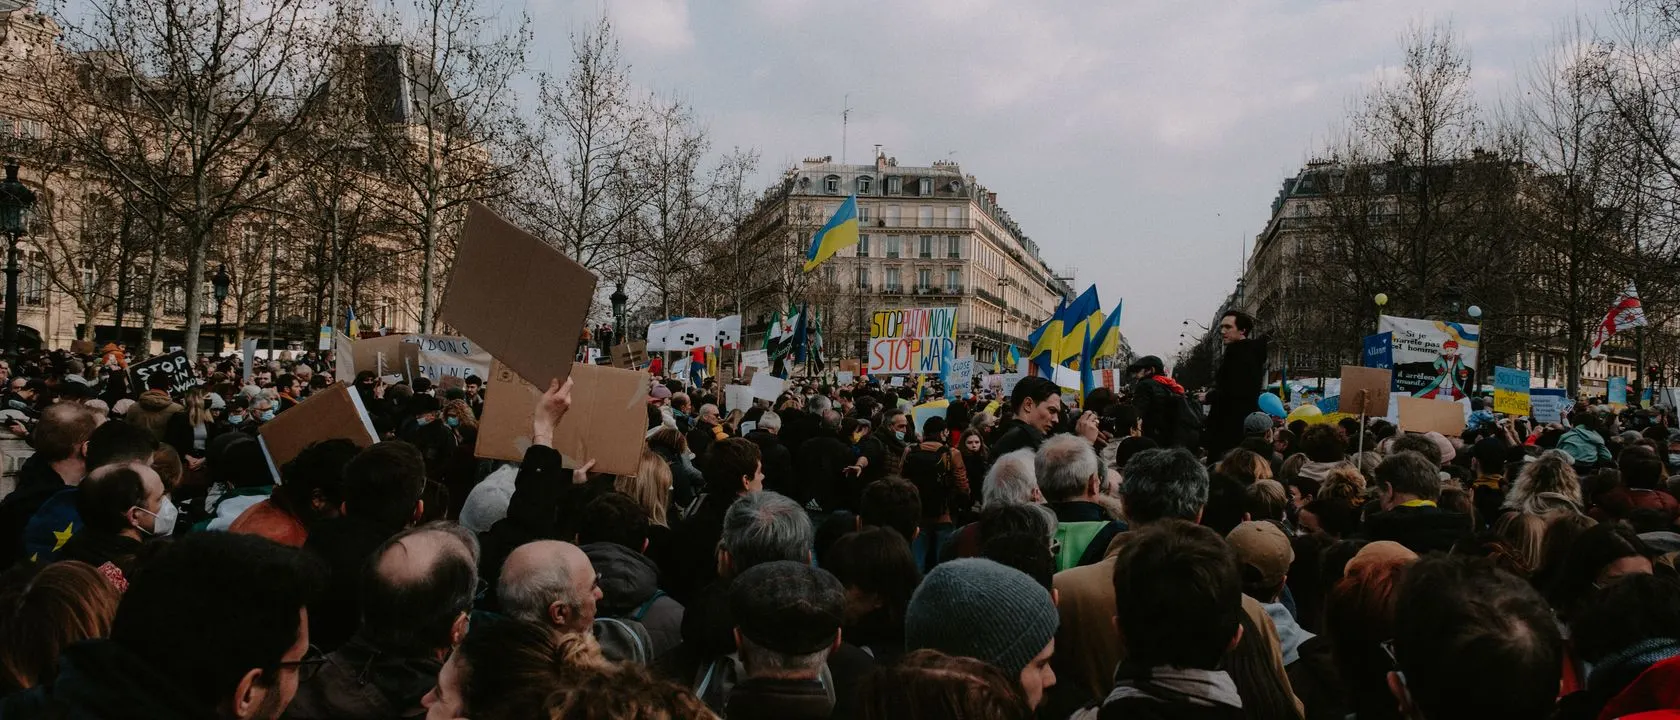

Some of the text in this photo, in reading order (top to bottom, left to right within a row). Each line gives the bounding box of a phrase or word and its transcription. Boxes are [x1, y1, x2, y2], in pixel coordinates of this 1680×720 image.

[872, 308, 957, 339] STOP PUTIN NOW
[137, 356, 186, 381] STOP
[871, 338, 921, 371] STOP
[952, 360, 971, 372] CLOSE
